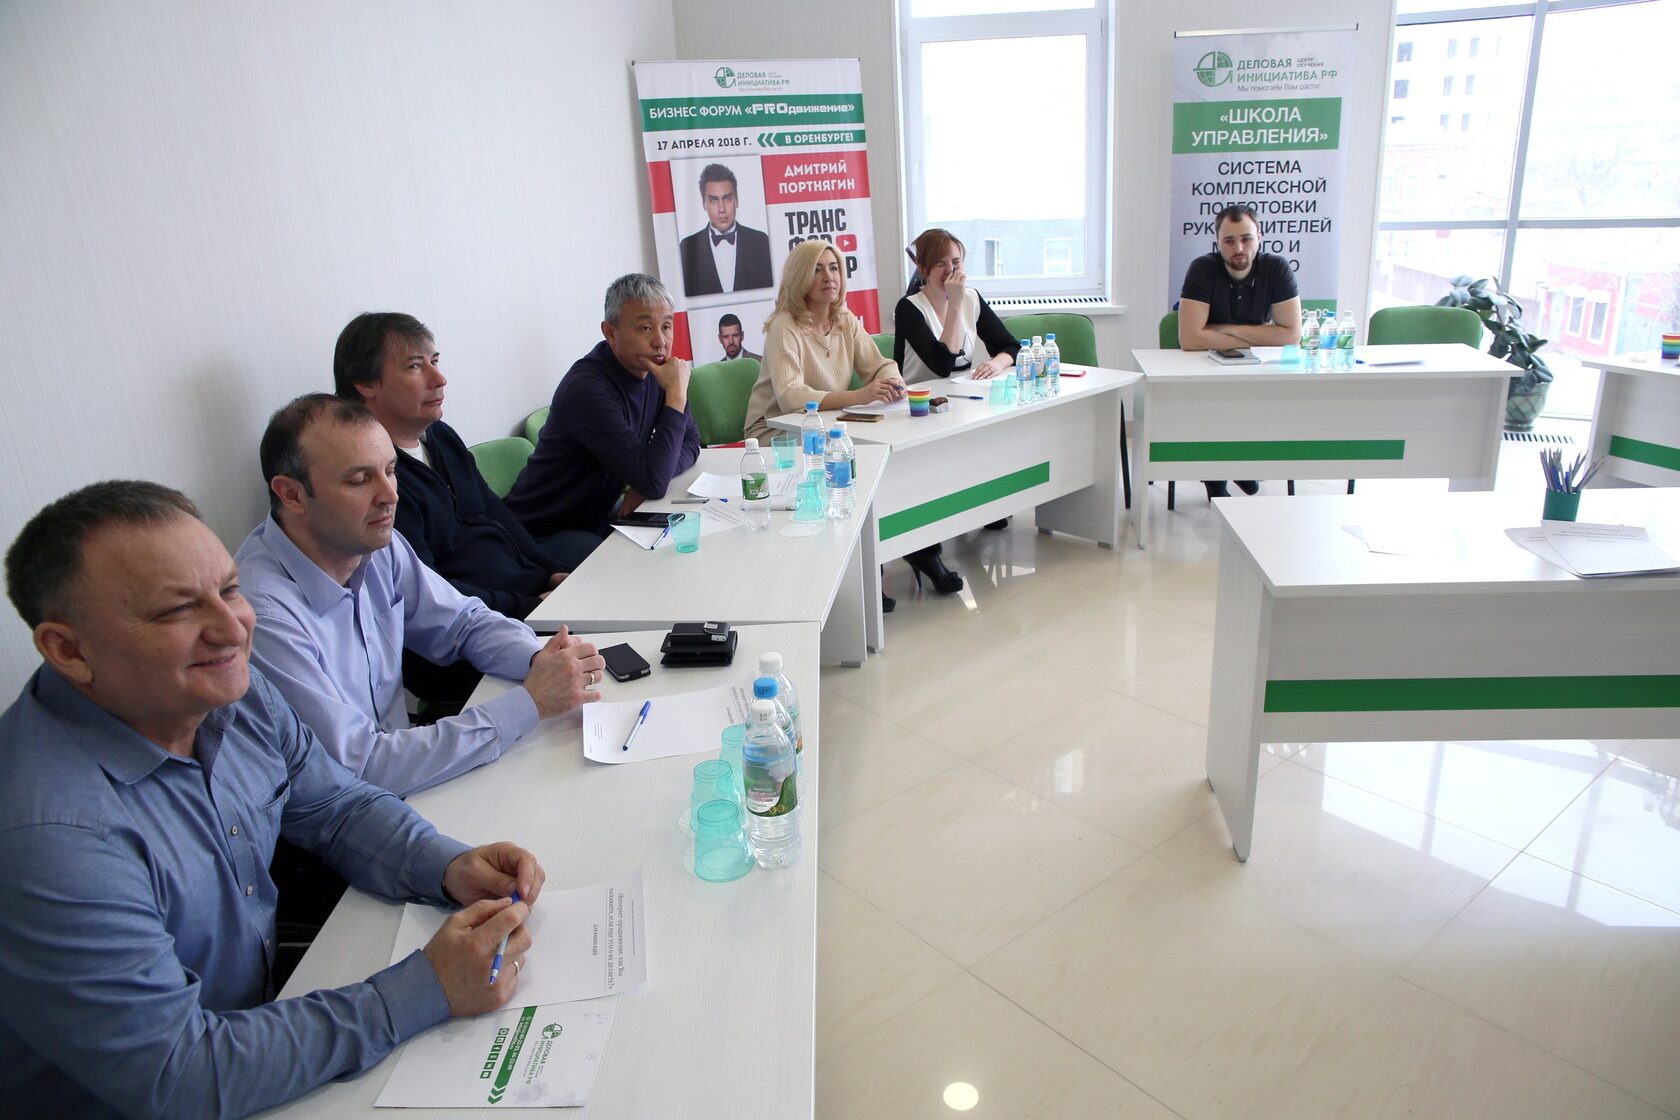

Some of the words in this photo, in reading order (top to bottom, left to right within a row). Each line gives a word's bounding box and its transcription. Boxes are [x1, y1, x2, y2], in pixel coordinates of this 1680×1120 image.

[1237, 58, 1292, 71] ДЕЛОВАЯ
[736, 71, 766, 79] ДЕЛОВАЯ
[649, 105, 697, 119] БИЗНЕС
[699, 106, 742, 117] ФОРУМ
[744, 102, 855, 116] «PROдвижение»
[1219, 107, 1302, 124] «ШКОЛА
[656, 140, 668, 150] 17
[671, 138, 714, 149] АПРЕЛЯ
[717, 137, 740, 147] 2018
[743, 137, 752, 146] Г.
[784, 134, 792, 144] В
[793, 132, 854, 144] ОРЕНБУРГЕ!
[1191, 127, 1328, 146] УПРАВЛЕНИЯ»
[783, 159, 848, 178] ДМИТРИЙ
[1218, 160, 1302, 176] СИСТЕМА
[778, 178, 856, 194] ПОРТНЯГИН
[1191, 177, 1327, 196] КОМПЛЕКСНОЙ
[1199, 200, 1317, 216] ПООТОВКИ
[784, 207, 847, 236] ТРАНС
[1183, 217, 1332, 237] РУКДИТЕЛЕЙ
[1289, 240, 1300, 253] И
[540, 1040, 553, 1064] ДЕЛОВАЯ
